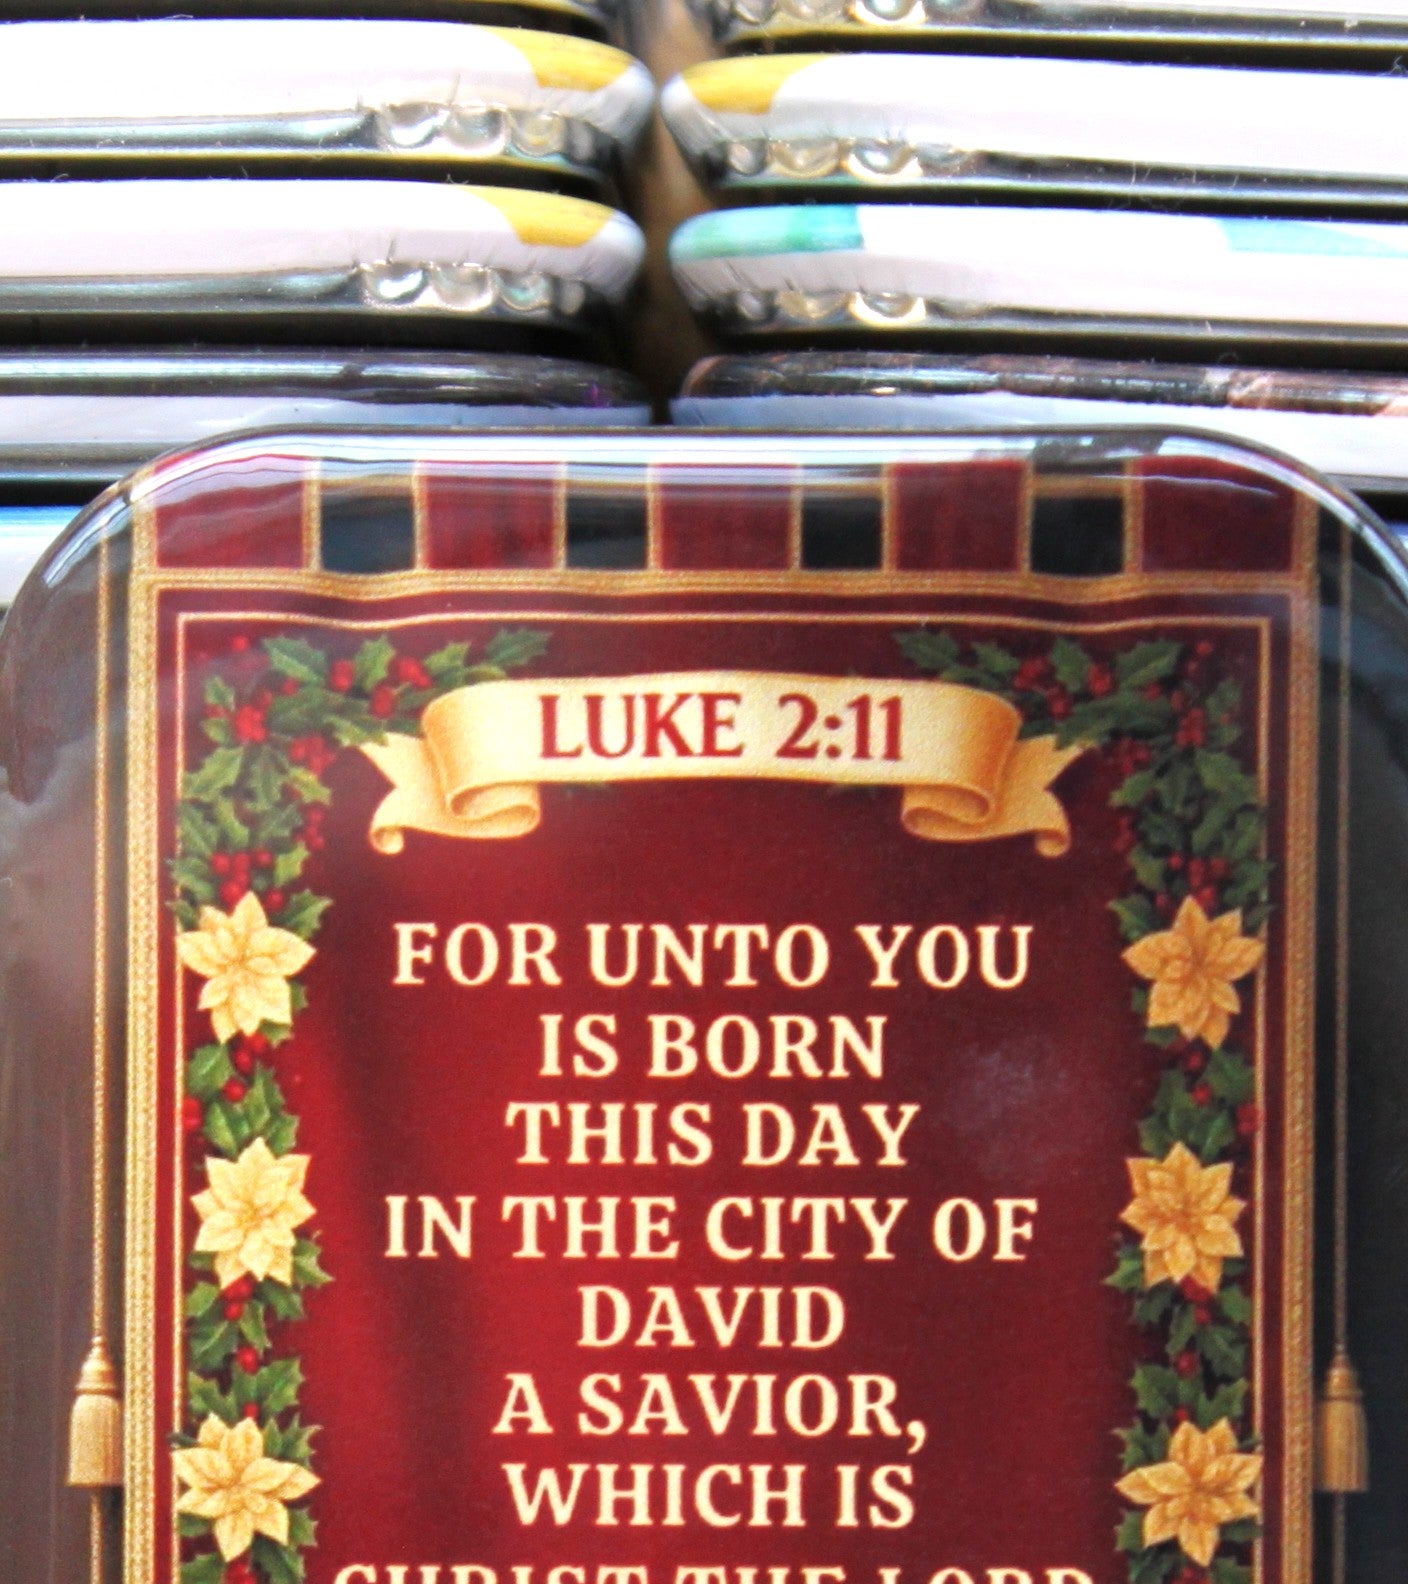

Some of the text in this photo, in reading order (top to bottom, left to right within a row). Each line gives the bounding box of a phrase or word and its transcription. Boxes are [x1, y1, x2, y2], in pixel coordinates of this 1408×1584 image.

[541, 692, 902, 762] LUKE 2:11
[393, 922, 1033, 989] FOR UNTO YOU
[539, 1014, 887, 1078] IS BORN
[505, 1101, 920, 1166] THIS DAY
[385, 1195, 1038, 1262] IN THE CITY OF
[577, 1285, 845, 1349] DAVID
[492, 1372, 926, 1454] A SAVIOR,
[501, 1462, 914, 1529] WHICH IS
